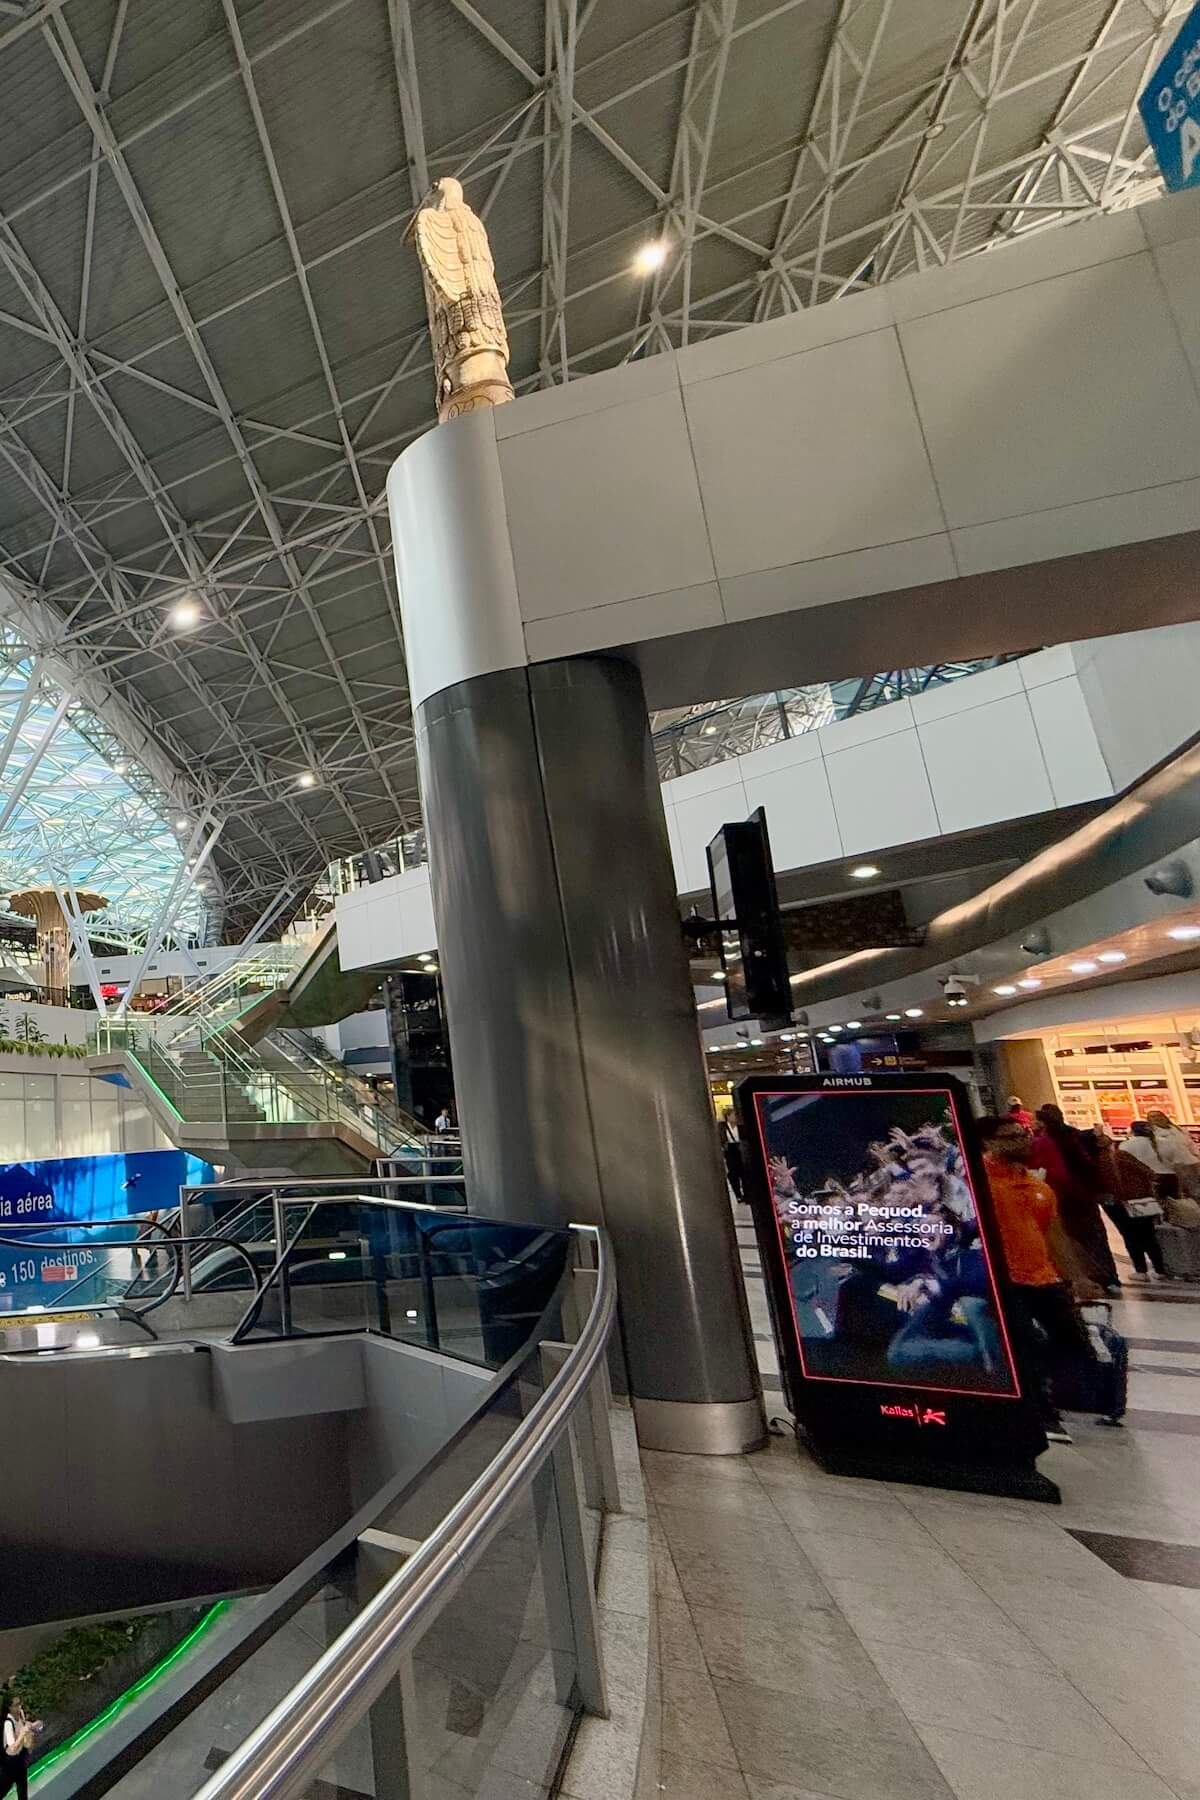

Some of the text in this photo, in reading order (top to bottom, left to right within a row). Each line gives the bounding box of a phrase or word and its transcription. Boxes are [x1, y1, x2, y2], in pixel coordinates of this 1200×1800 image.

[17, 1192, 54, 1214] aérea
[788, 1201, 842, 1216] Somos
[844, 1205, 855, 1216] a
[791, 1217, 954, 1235] a melhor Assessoria
[793, 1232, 931, 1248] de Investimentos
[796, 1244, 873, 1259] do Brasil.
[11, 1259, 36, 1284] 150
[879, 1404, 914, 1418] Kallas
